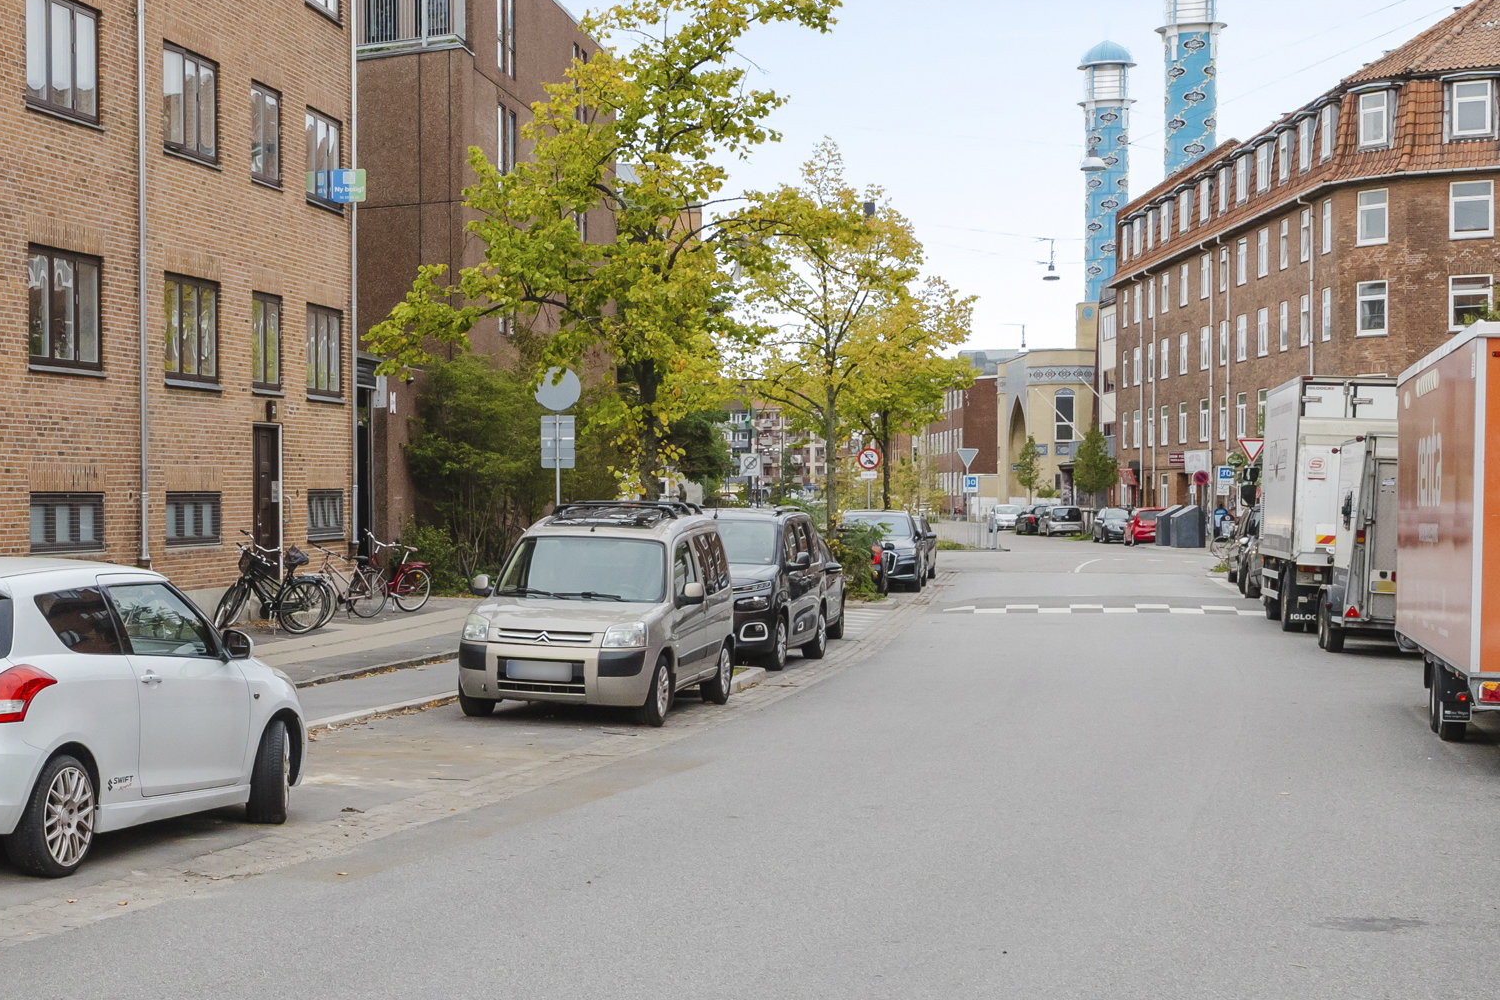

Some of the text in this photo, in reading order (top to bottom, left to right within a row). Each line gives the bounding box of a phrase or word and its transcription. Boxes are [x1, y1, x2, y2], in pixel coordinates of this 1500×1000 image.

[334, 186, 344, 194] Ny
[1417, 417, 1442, 507] renta
[113, 775, 134, 784] SWIFT
